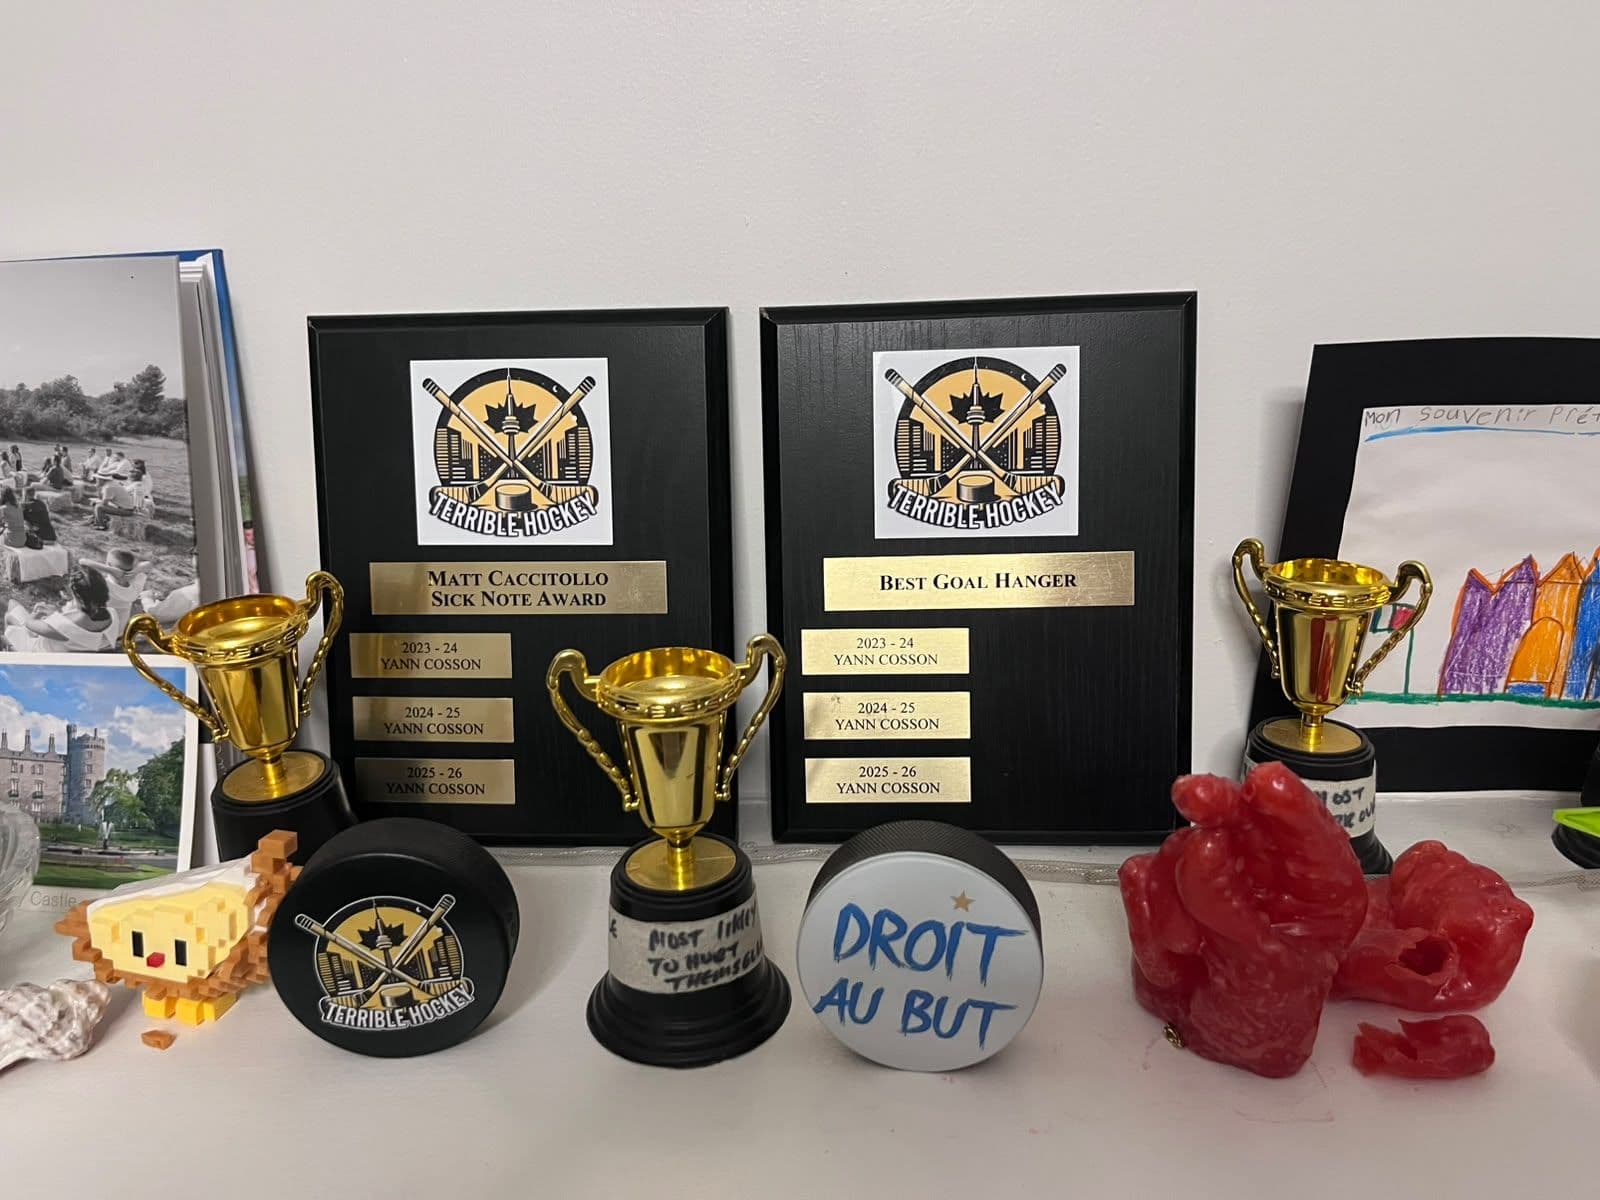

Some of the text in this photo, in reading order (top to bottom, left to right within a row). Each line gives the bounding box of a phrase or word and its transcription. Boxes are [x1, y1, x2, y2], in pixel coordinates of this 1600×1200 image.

[1364, 408, 1401, 427] Mon
[1419, 407, 1537, 425] souvenir
[890, 482, 1063, 528] TERRIBLE HOCKEY
[432, 492, 597, 536] TERRIBLE HOCKEY
[428, 570, 608, 587] MATT CACCITOLLO
[880, 573, 1077, 591] BEST GOAL HANGER
[432, 592, 606, 607] SICK NOTE AWARD
[401, 643, 431, 654] 2023
[443, 643, 457, 654] 24
[856, 638, 886, 649] 2023
[899, 638, 914, 649] 24
[381, 658, 481, 670] YANN COSSON
[834, 654, 938, 666] YANN COSSON
[405, 707, 434, 718] 2024
[446, 707, 460, 718] 25
[858, 703, 888, 714] 2024
[900, 703, 915, 714] 25
[384, 723, 484, 735] YANN COSSON
[835, 719, 939, 730] YANN COSSON
[407, 767, 436, 778] 2025
[448, 767, 462, 778] 26
[859, 766, 889, 778] 2025
[901, 766, 916, 778] 26
[386, 783, 485, 795] YANN COSSON
[836, 782, 940, 794] YANN COSSON
[30, 891, 76, 906] Castle
[649, 929, 704, 951] MOST
[833, 903, 1028, 987] DROIT
[647, 942, 738, 976] TO HURT
[323, 985, 473, 1029] TERRIBLE HOCKEY
[813, 977, 1017, 1049] AU BUT
